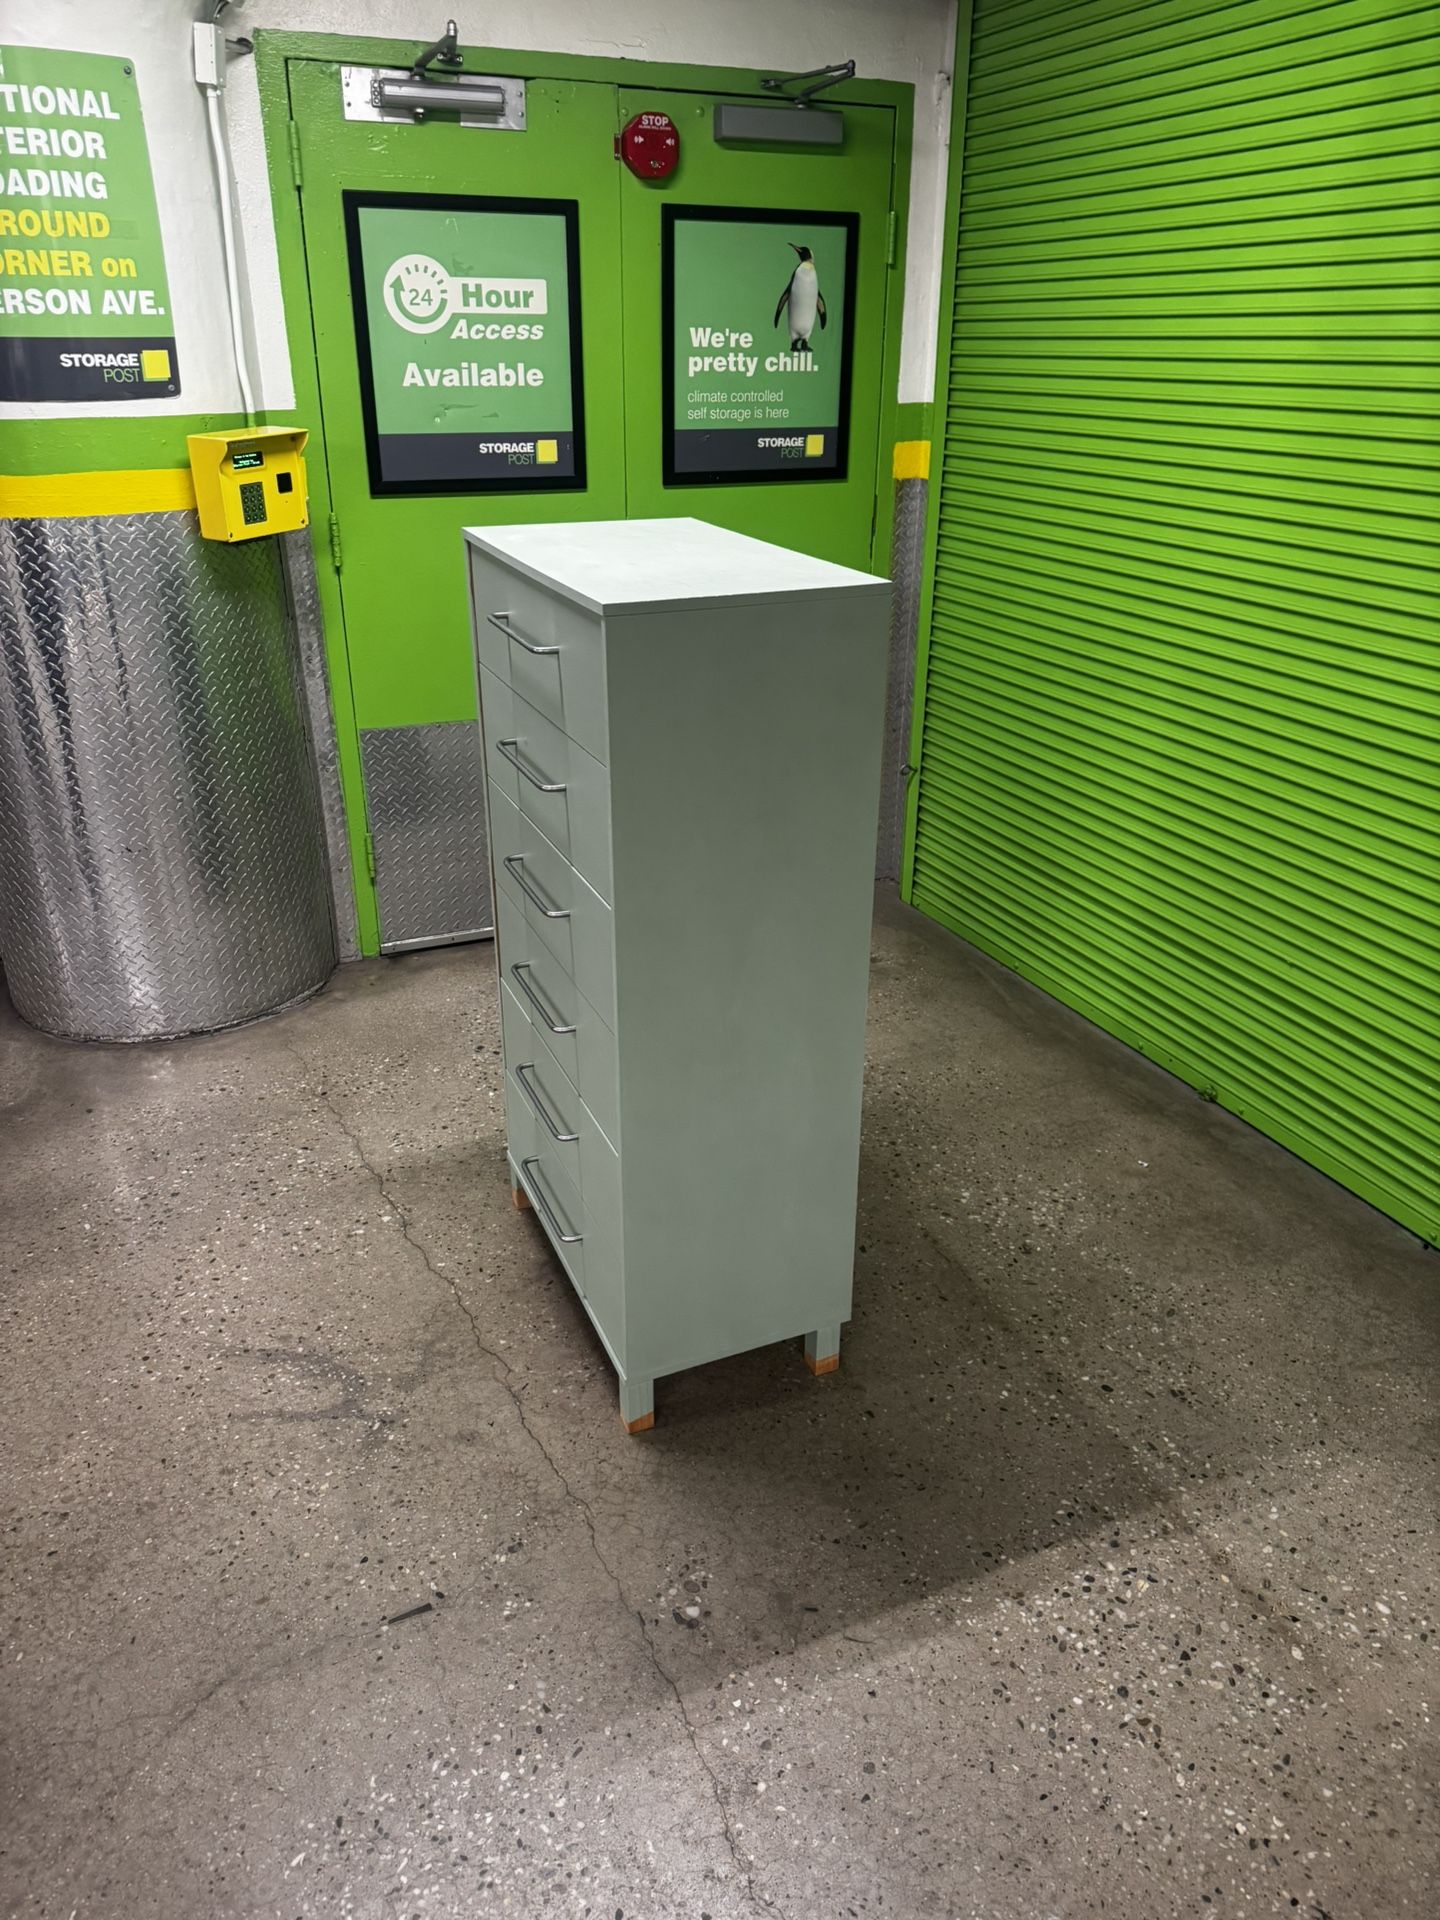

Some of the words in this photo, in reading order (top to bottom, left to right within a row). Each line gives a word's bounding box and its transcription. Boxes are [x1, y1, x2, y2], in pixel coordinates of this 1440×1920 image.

[0, 84, 120, 120] TIONAL
[642, 115, 669, 126] STOP
[0, 128, 107, 159] ERIOR
[0, 169, 108, 199] ADING
[0, 209, 111, 238] ROUND
[0, 249, 92, 277] RNER
[102, 257, 137, 278] on
[0, 288, 92, 314] RSON
[102, 289, 165, 315] AVE.
[409, 288, 433, 306] 24
[461, 283, 535, 308] Hour
[450, 319, 544, 340] Access
[690, 327, 753, 348] We're
[59, 353, 139, 368] STORAGE
[688, 353, 758, 377] pretty
[765, 351, 819, 372] chill.
[104, 368, 140, 383] POST
[402, 362, 544, 387] Available
[687, 390, 727, 403] climate
[730, 389, 783, 403] controlled
[687, 407, 707, 420] self
[710, 407, 751, 421] storage
[754, 407, 763, 419] is
[766, 406, 789, 419] here
[479, 442, 535, 454] STORAGE
[757, 437, 805, 448] STORAGE
[781, 448, 804, 458] POST
[508, 454, 535, 465] POST
